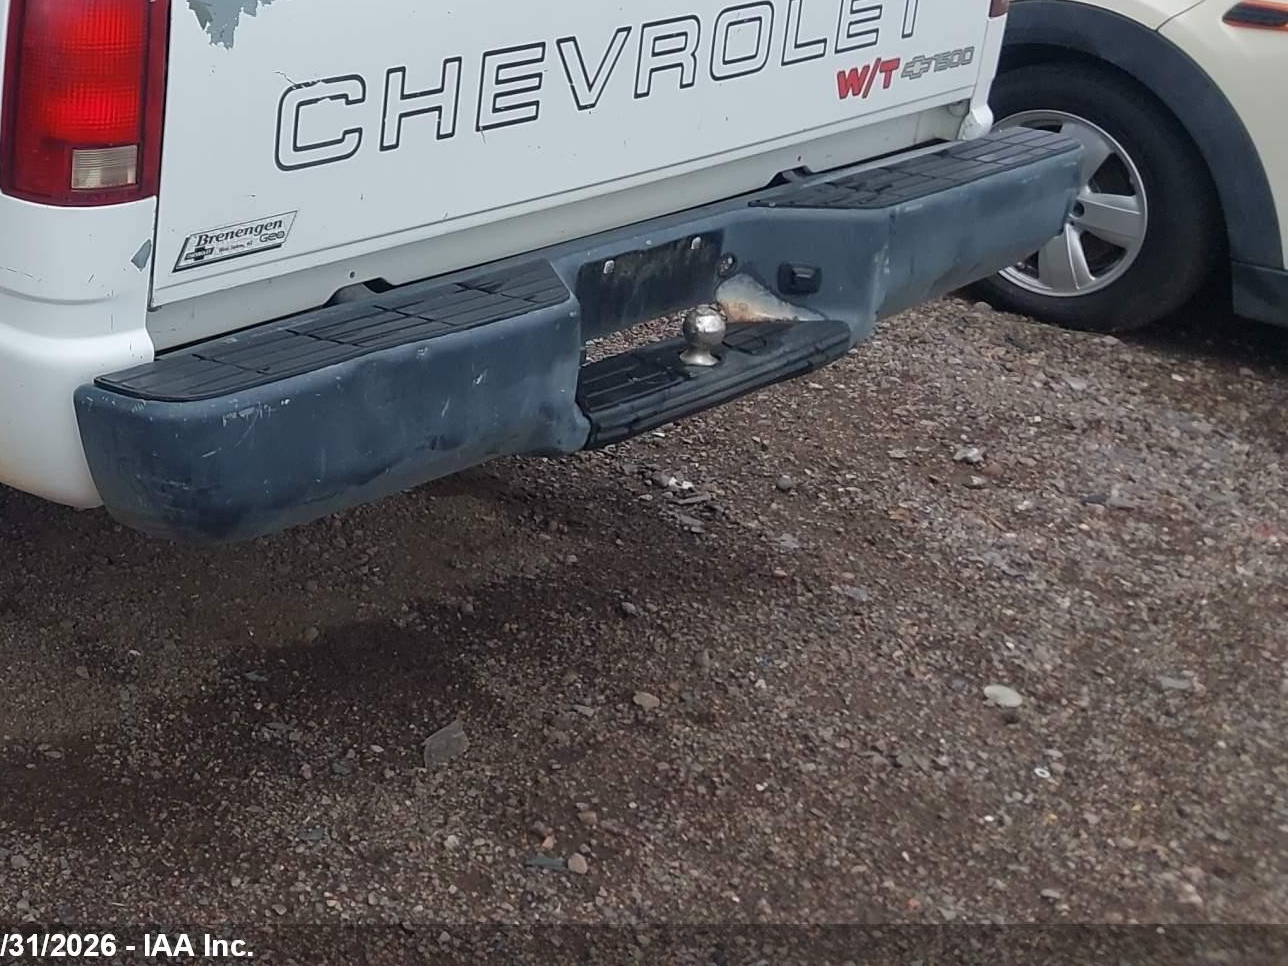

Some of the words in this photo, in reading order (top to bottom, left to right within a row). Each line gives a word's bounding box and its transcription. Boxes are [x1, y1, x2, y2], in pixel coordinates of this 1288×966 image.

[836, 57, 901, 100] W/T
[932, 46, 975, 73] 1500
[194, 219, 283, 247] Brenengen
